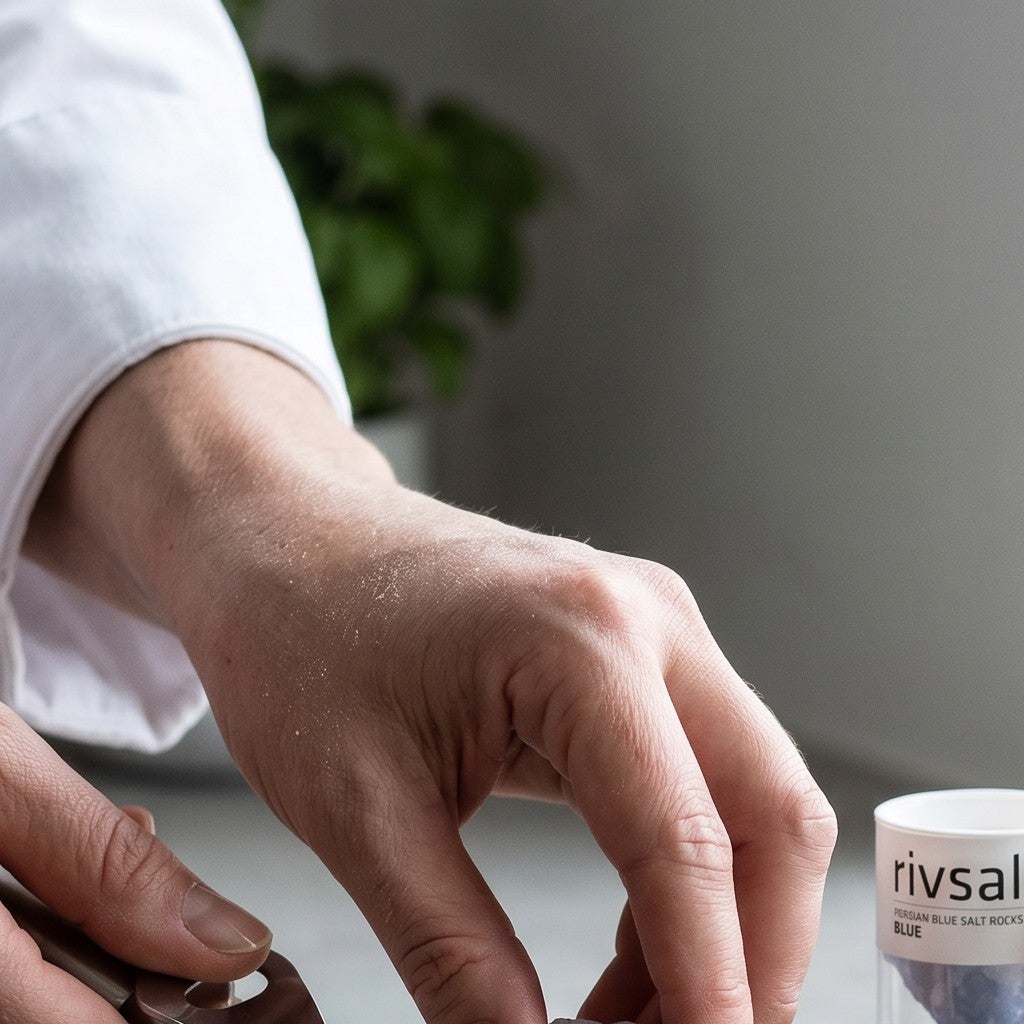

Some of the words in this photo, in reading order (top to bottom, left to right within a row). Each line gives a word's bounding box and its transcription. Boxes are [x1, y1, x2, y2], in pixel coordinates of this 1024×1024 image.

[894, 907, 929, 923] PERSIAN
[932, 915, 957, 925] BLUE
[961, 916, 986, 926] SALT
[989, 915, 1023, 926] ROCKS
[894, 921, 922, 938] BLUE
